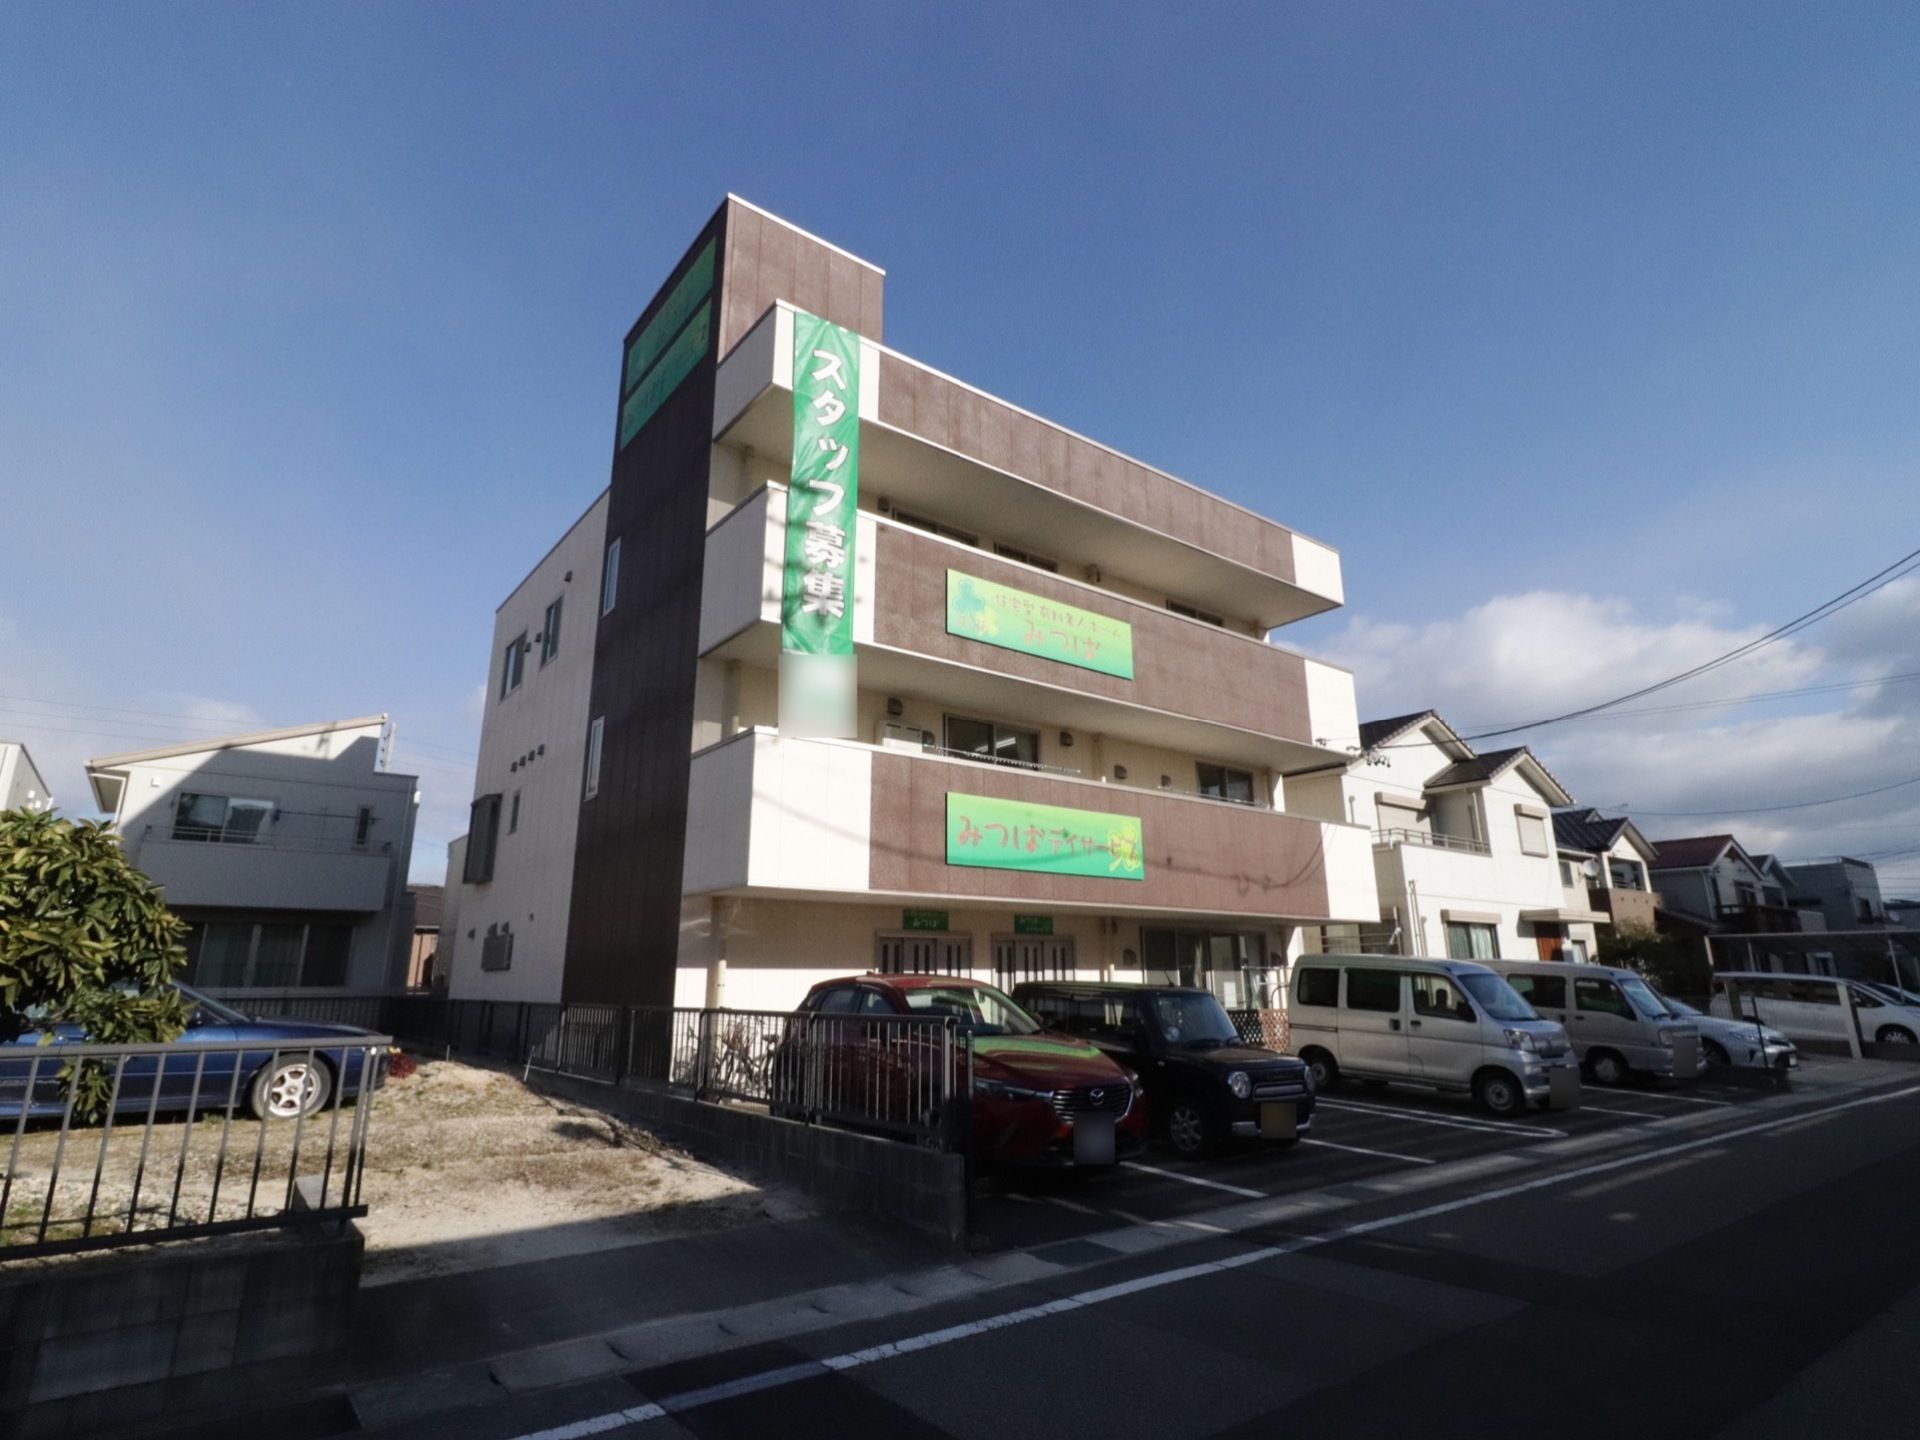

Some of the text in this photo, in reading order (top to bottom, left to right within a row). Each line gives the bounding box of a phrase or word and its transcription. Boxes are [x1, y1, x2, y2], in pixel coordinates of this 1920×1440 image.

[802, 350, 848, 619] スタッフ募集
[1025, 618, 1101, 660] みつば
